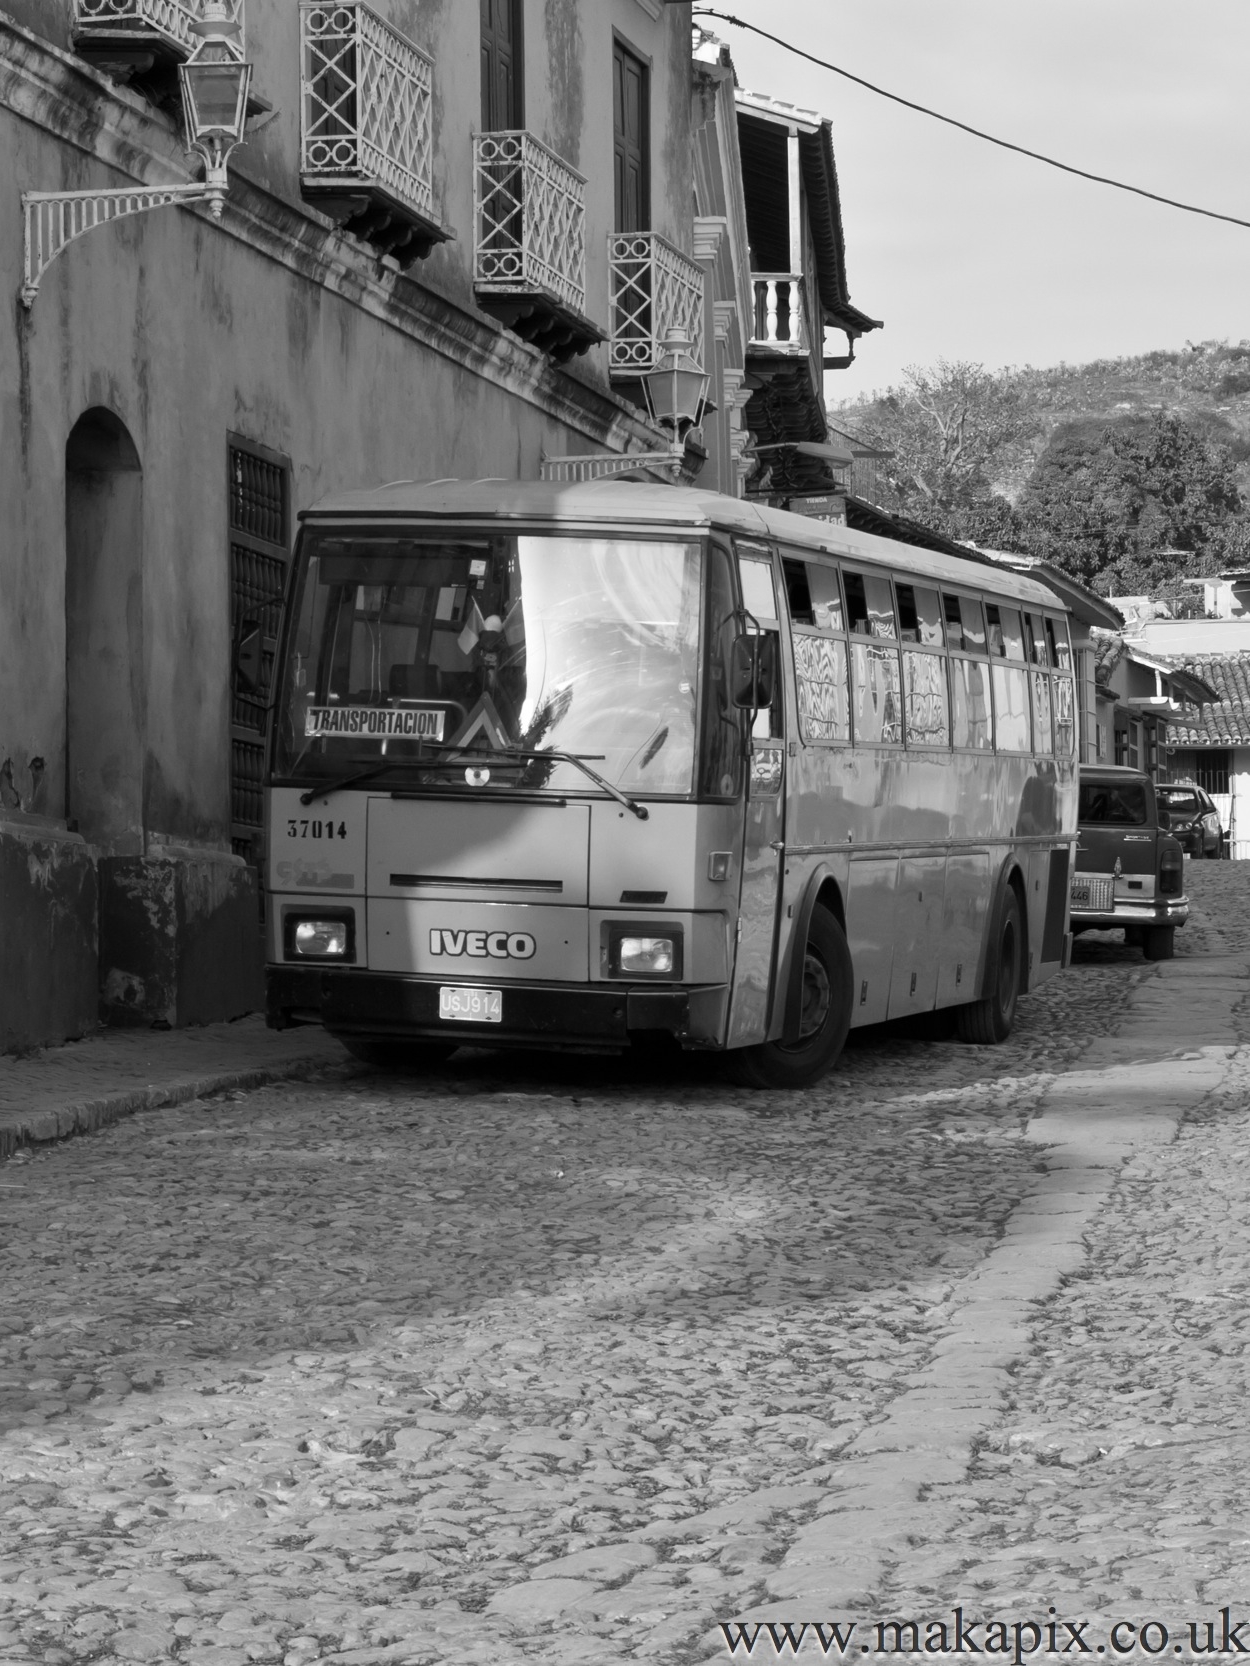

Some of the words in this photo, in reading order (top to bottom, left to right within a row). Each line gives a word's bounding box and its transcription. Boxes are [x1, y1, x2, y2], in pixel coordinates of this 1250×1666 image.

[310, 710, 438, 735] TRANSPORTACION
[287, 819, 347, 839] 37014
[429, 928, 537, 960] IVECO
[441, 994, 501, 1014] USJ914
